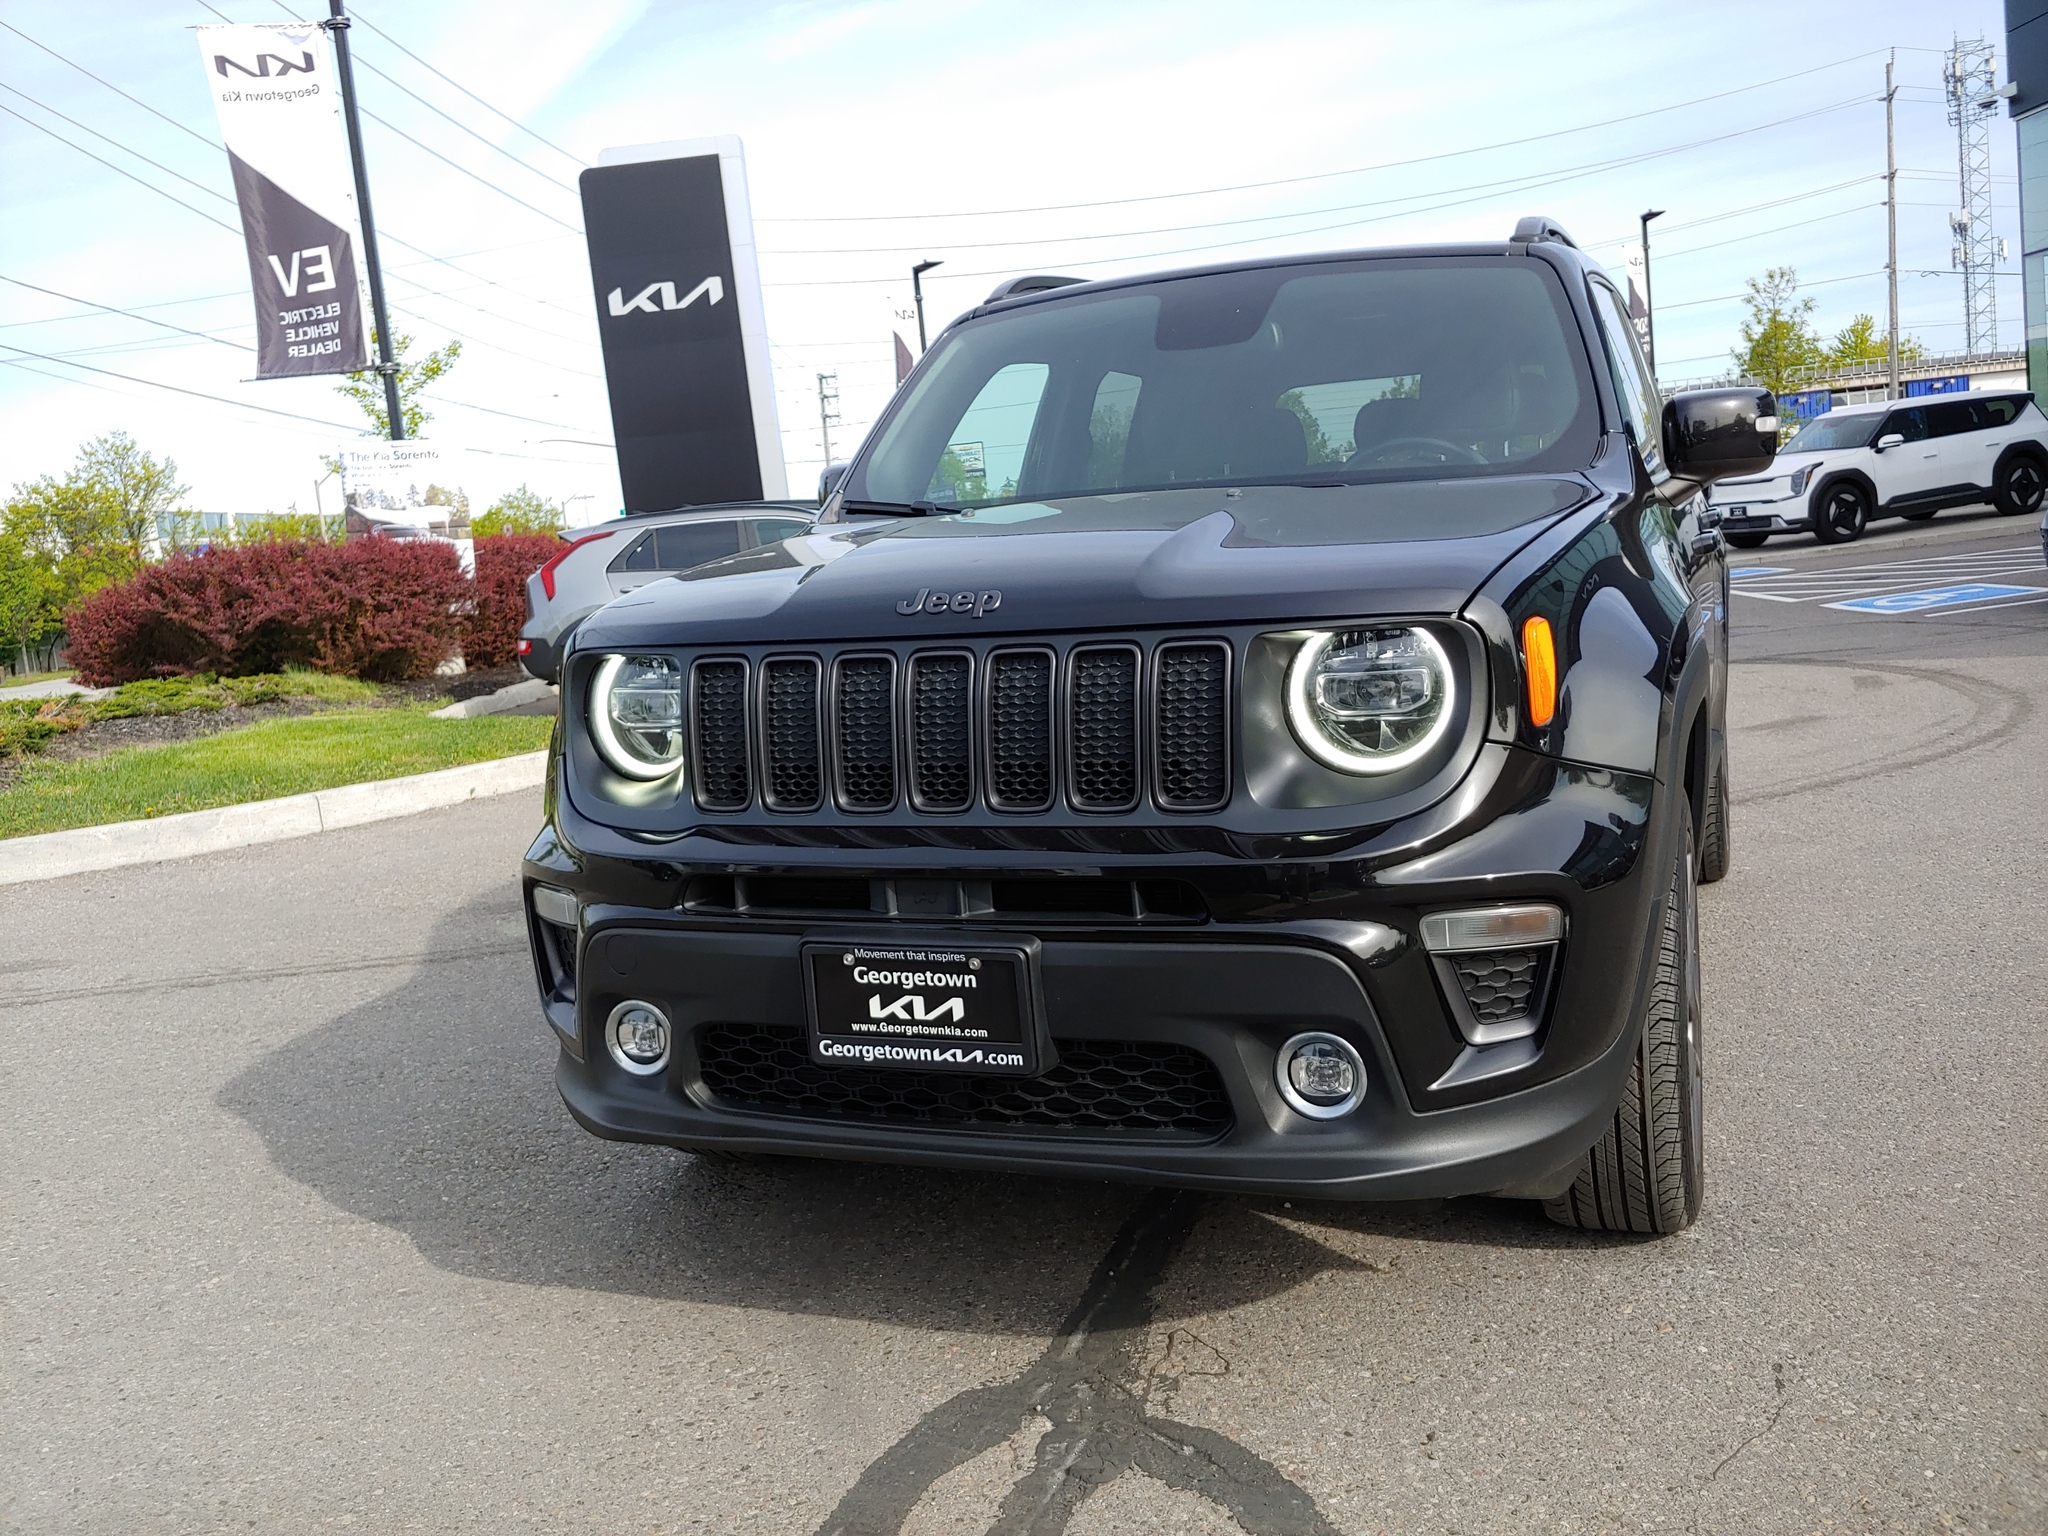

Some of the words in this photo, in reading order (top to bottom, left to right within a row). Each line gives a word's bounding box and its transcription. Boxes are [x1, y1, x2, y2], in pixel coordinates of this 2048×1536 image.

[607, 276, 724, 317] KIA
[349, 452, 370, 462] The
[373, 452, 390, 461] Kia
[393, 450, 439, 461] Sorento
[896, 588, 1002, 619] Jeep
[854, 948, 905, 959] Movement
[906, 950, 926, 960] that
[927, 951, 966, 963] inspires
[853, 966, 977, 989] Georgetown
[868, 993, 965, 1022] KIA
[851, 1022, 988, 1038] www.Georgetownkia.com
